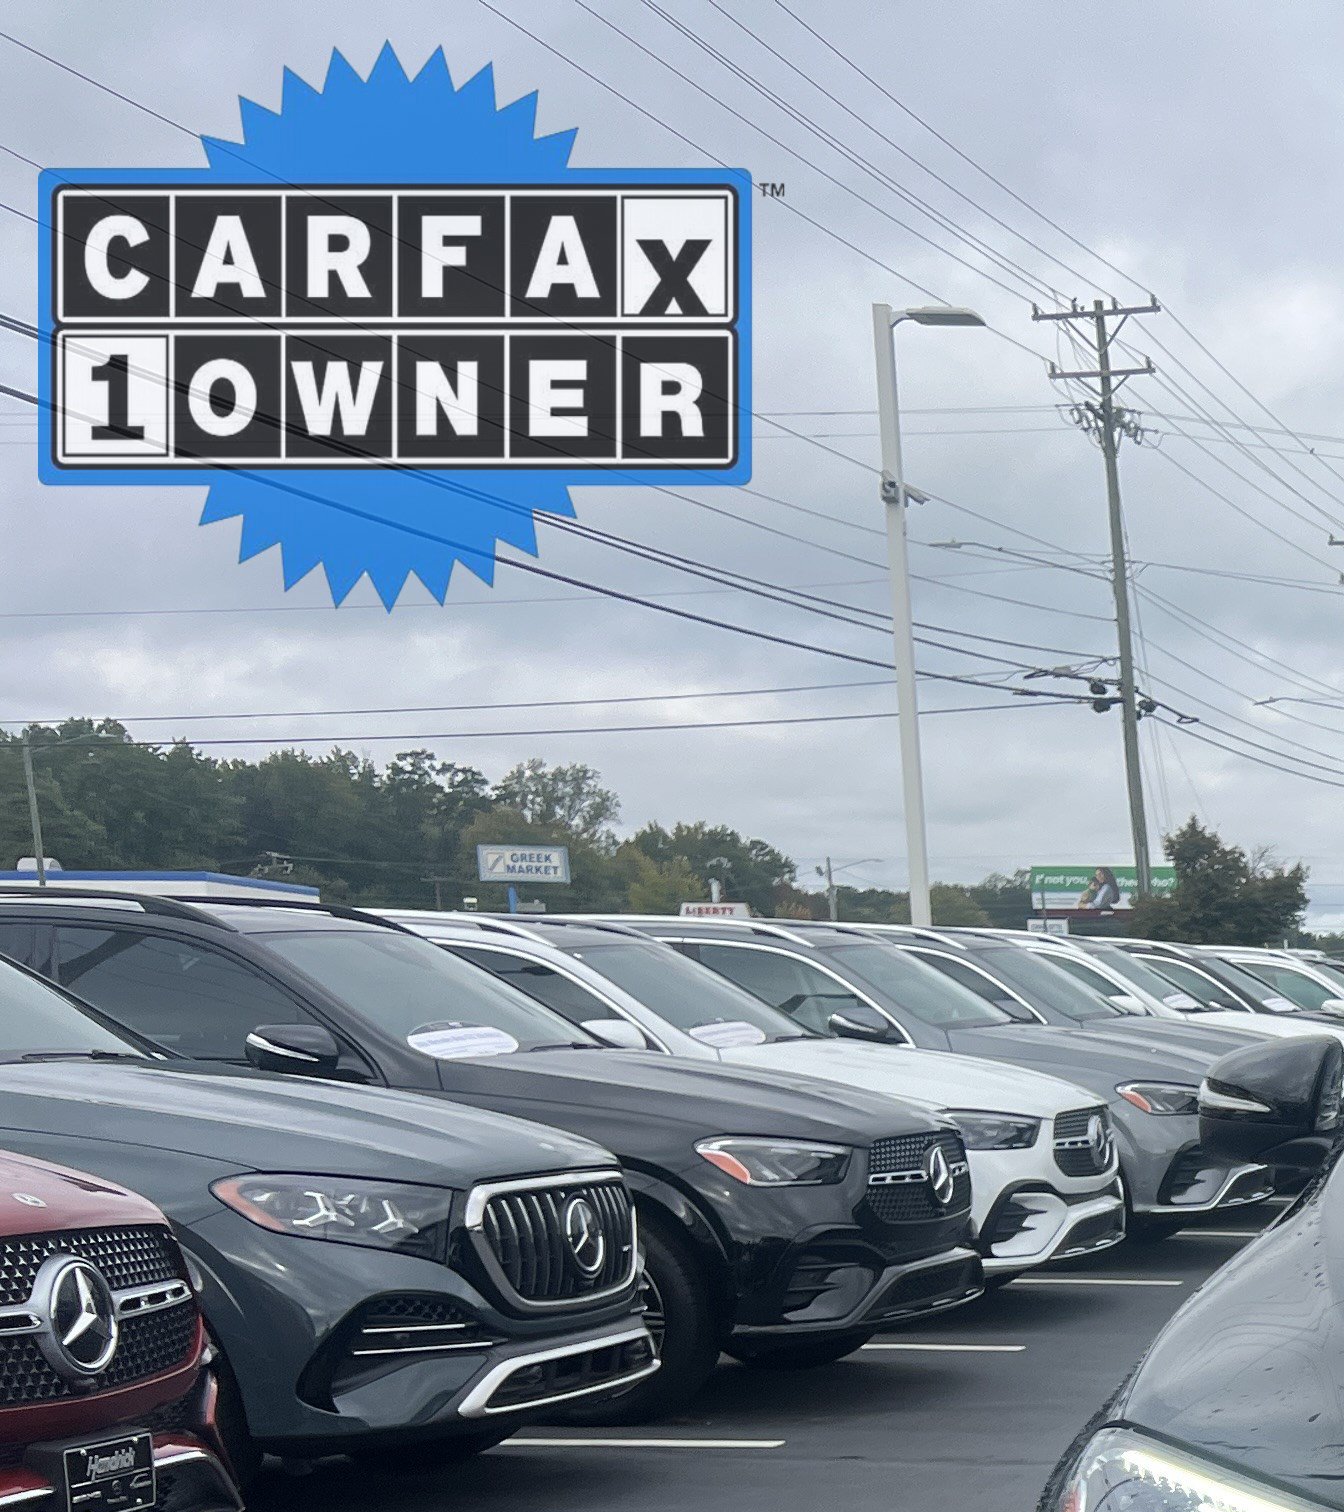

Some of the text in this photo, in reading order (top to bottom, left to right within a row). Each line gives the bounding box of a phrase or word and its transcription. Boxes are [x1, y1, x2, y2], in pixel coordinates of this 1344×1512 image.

[510, 853, 552, 863] GREEK
[506, 864, 560, 875] MARKET
[1044, 875, 1065, 885] not
